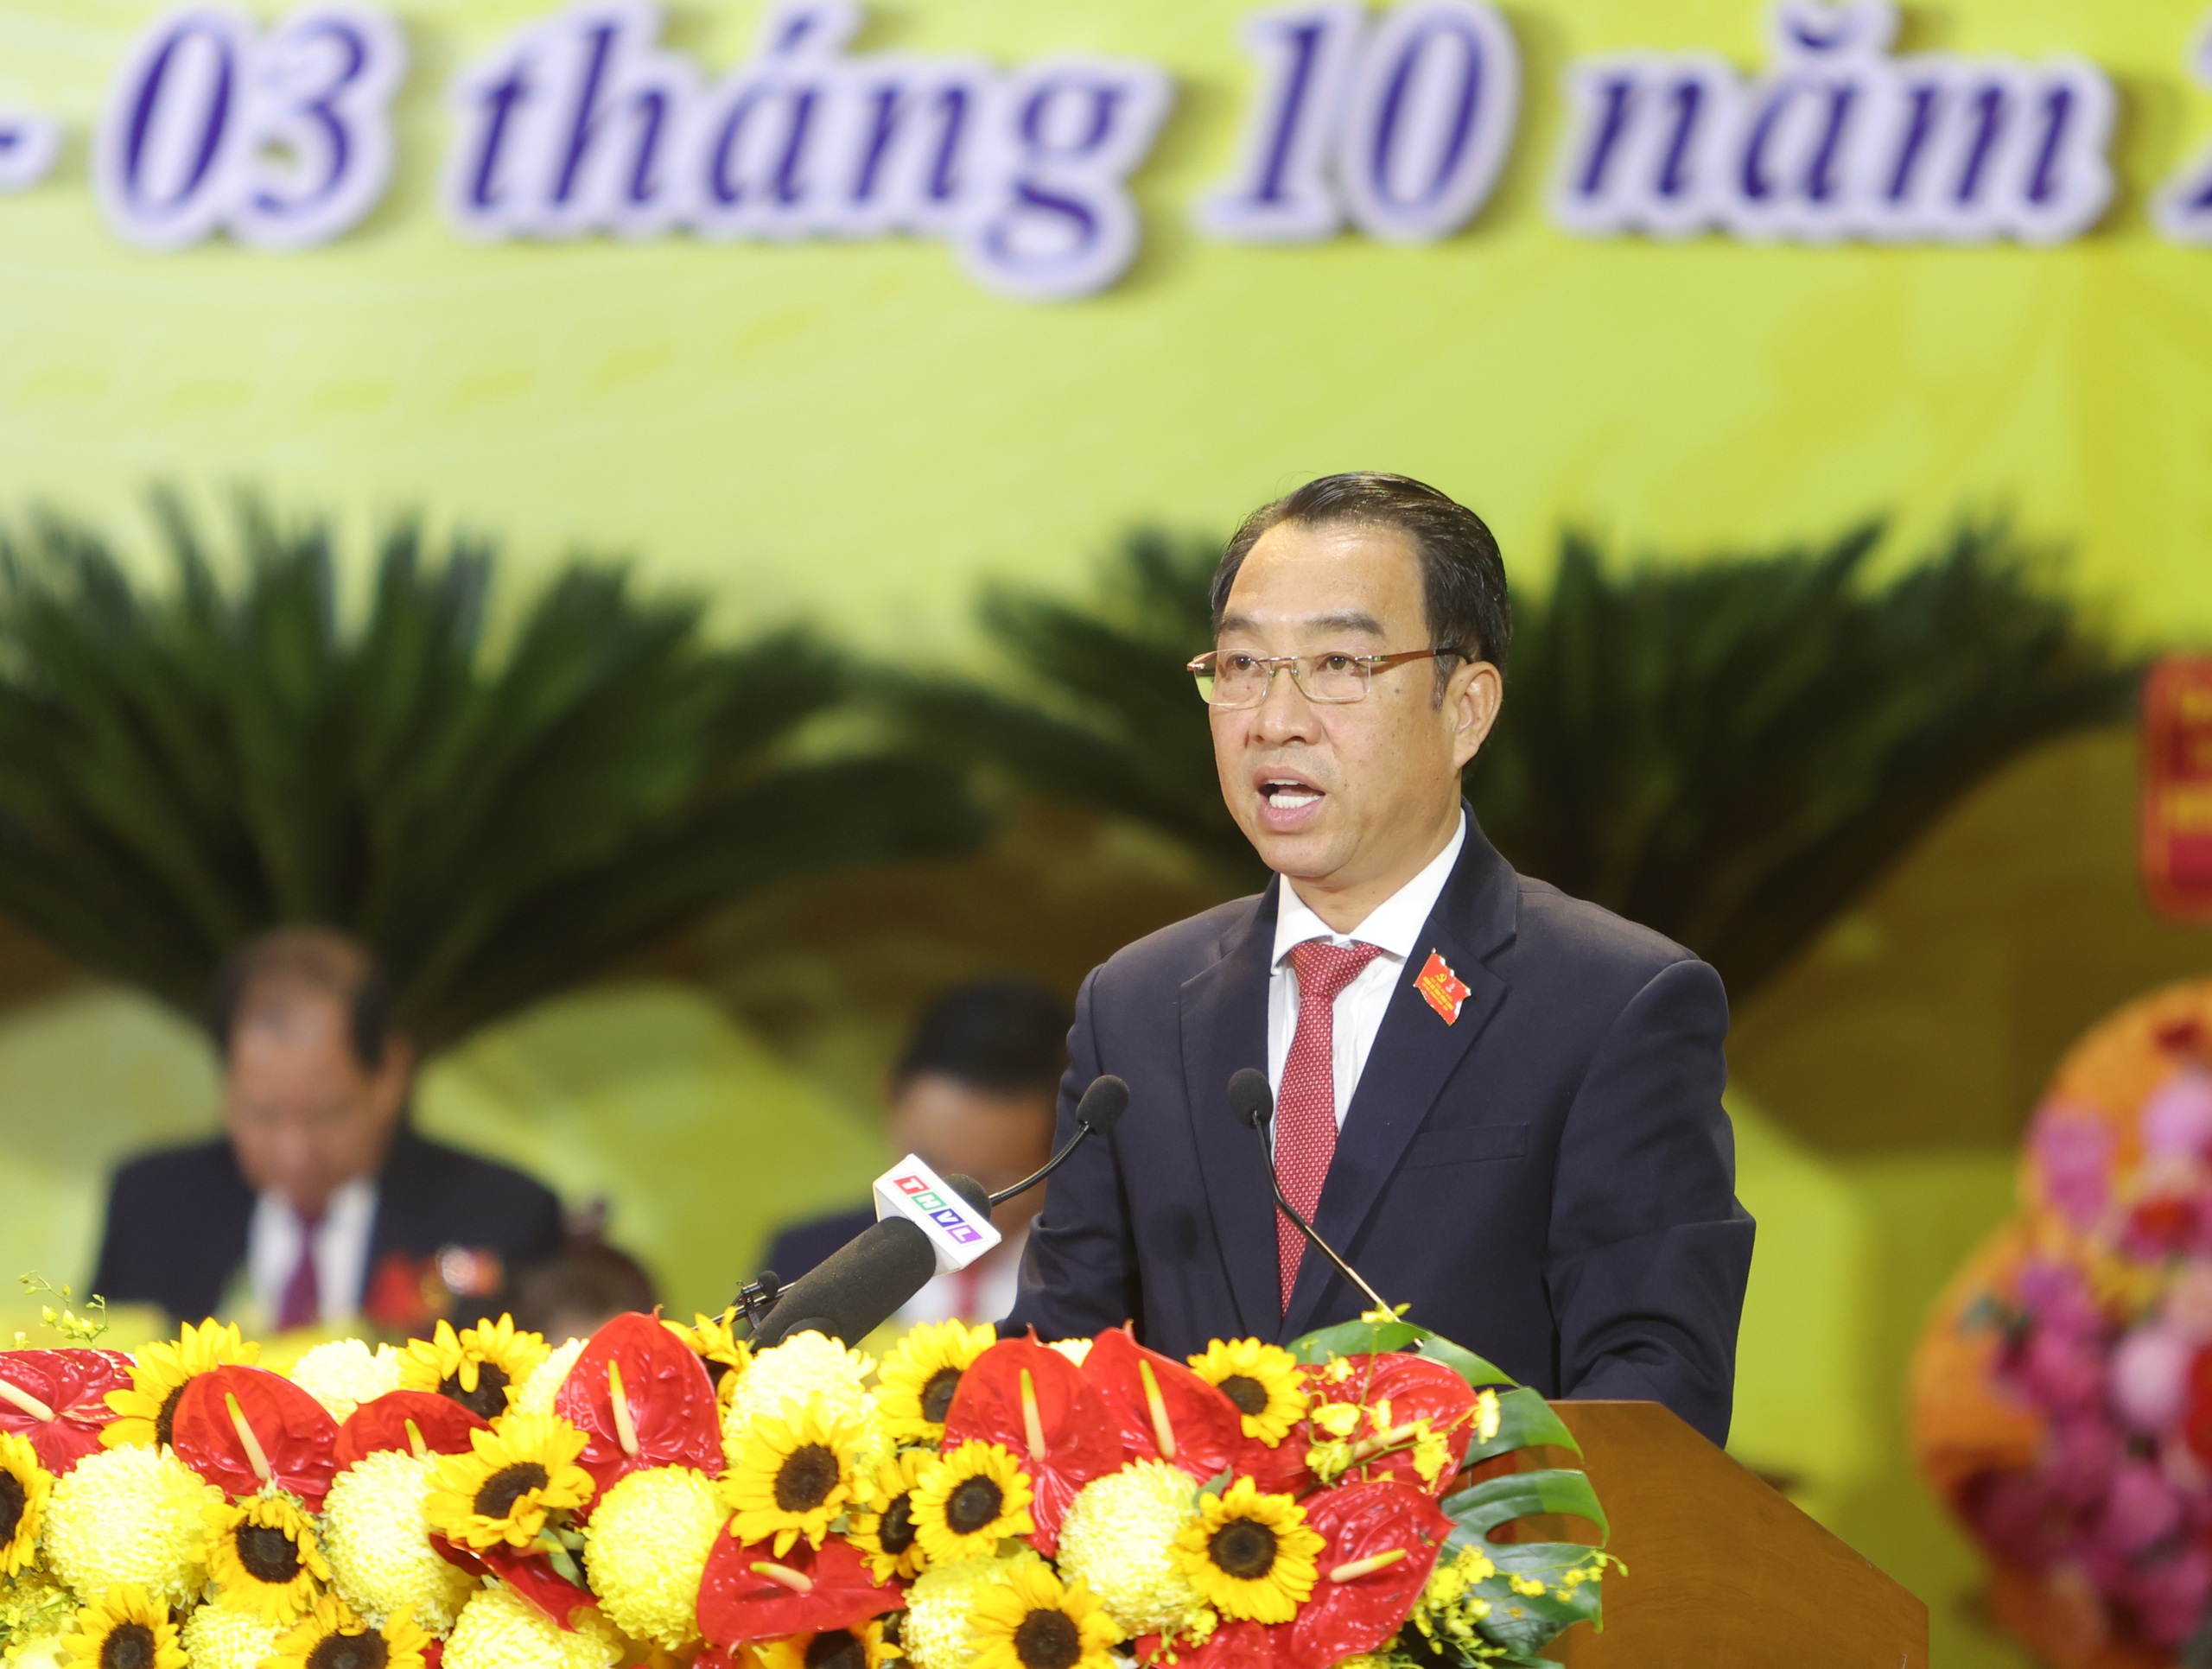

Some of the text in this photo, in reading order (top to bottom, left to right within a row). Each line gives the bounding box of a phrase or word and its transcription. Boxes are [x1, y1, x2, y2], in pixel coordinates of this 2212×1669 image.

[109, 7, 385, 232] 03
[454, 4, 1154, 282] tháng
[1217, 7, 1497, 227] 10
[1567, 3, 2100, 231] năm
[899, 1176, 978, 1243] THVL
